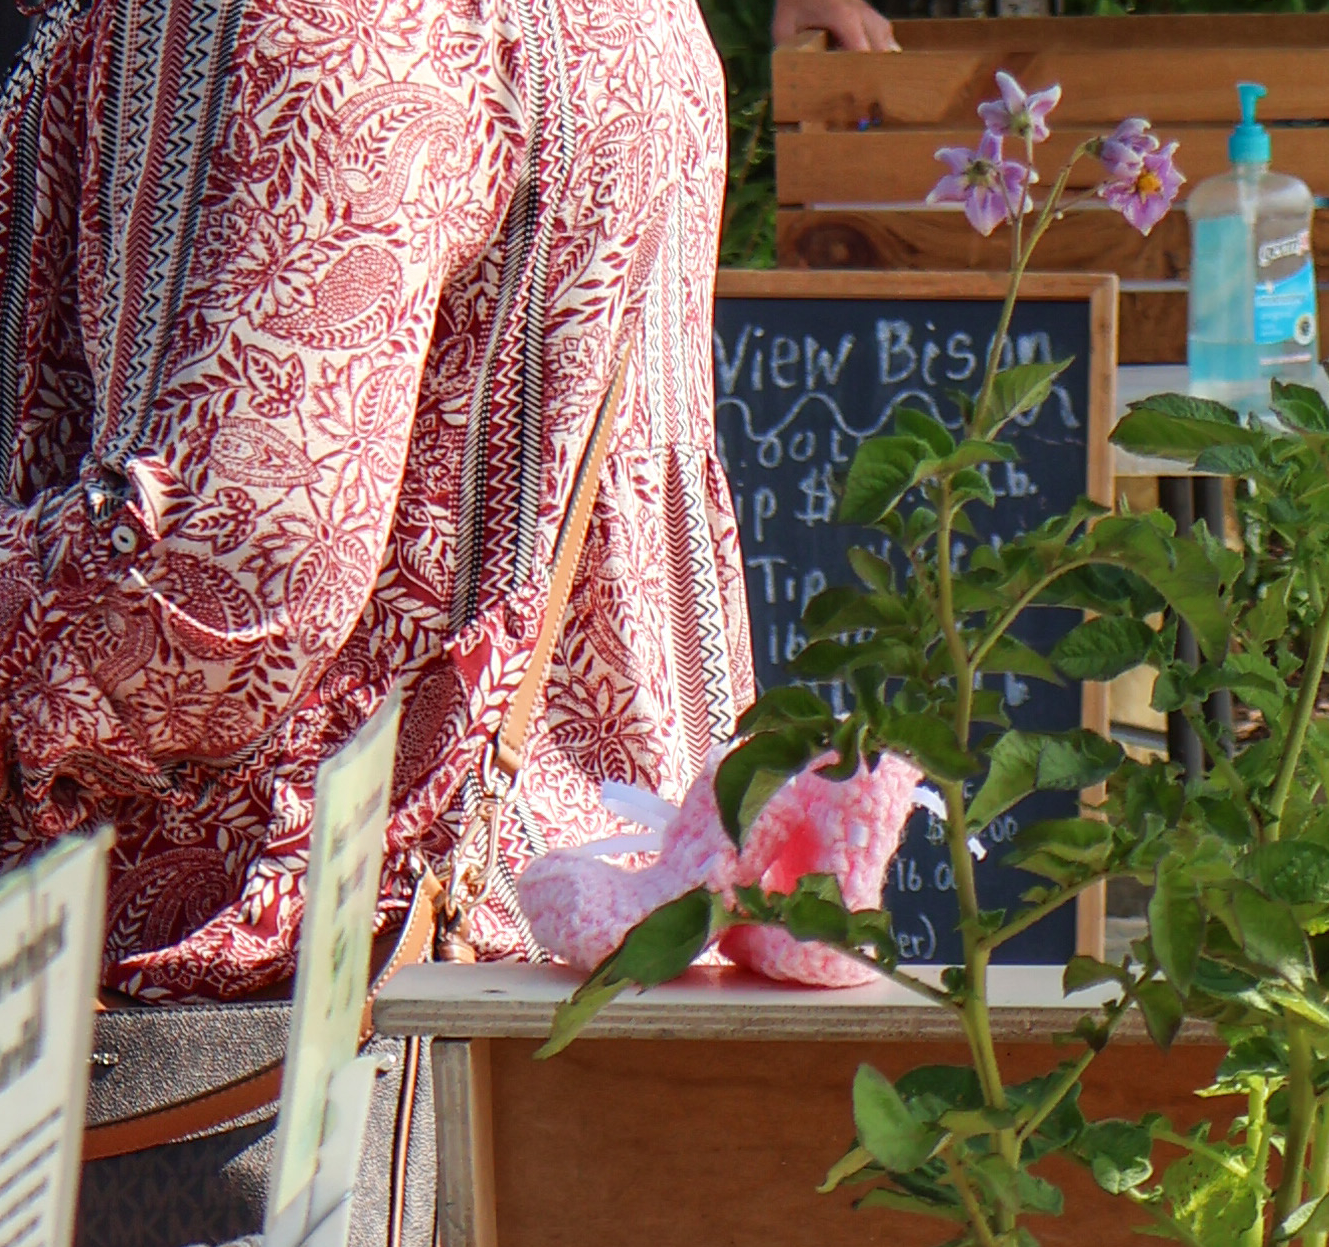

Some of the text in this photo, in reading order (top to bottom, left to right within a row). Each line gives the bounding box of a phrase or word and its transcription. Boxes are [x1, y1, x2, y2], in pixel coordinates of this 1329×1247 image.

[713, 317, 1054, 395] View Bison
[746, 555, 828, 619] Tip
